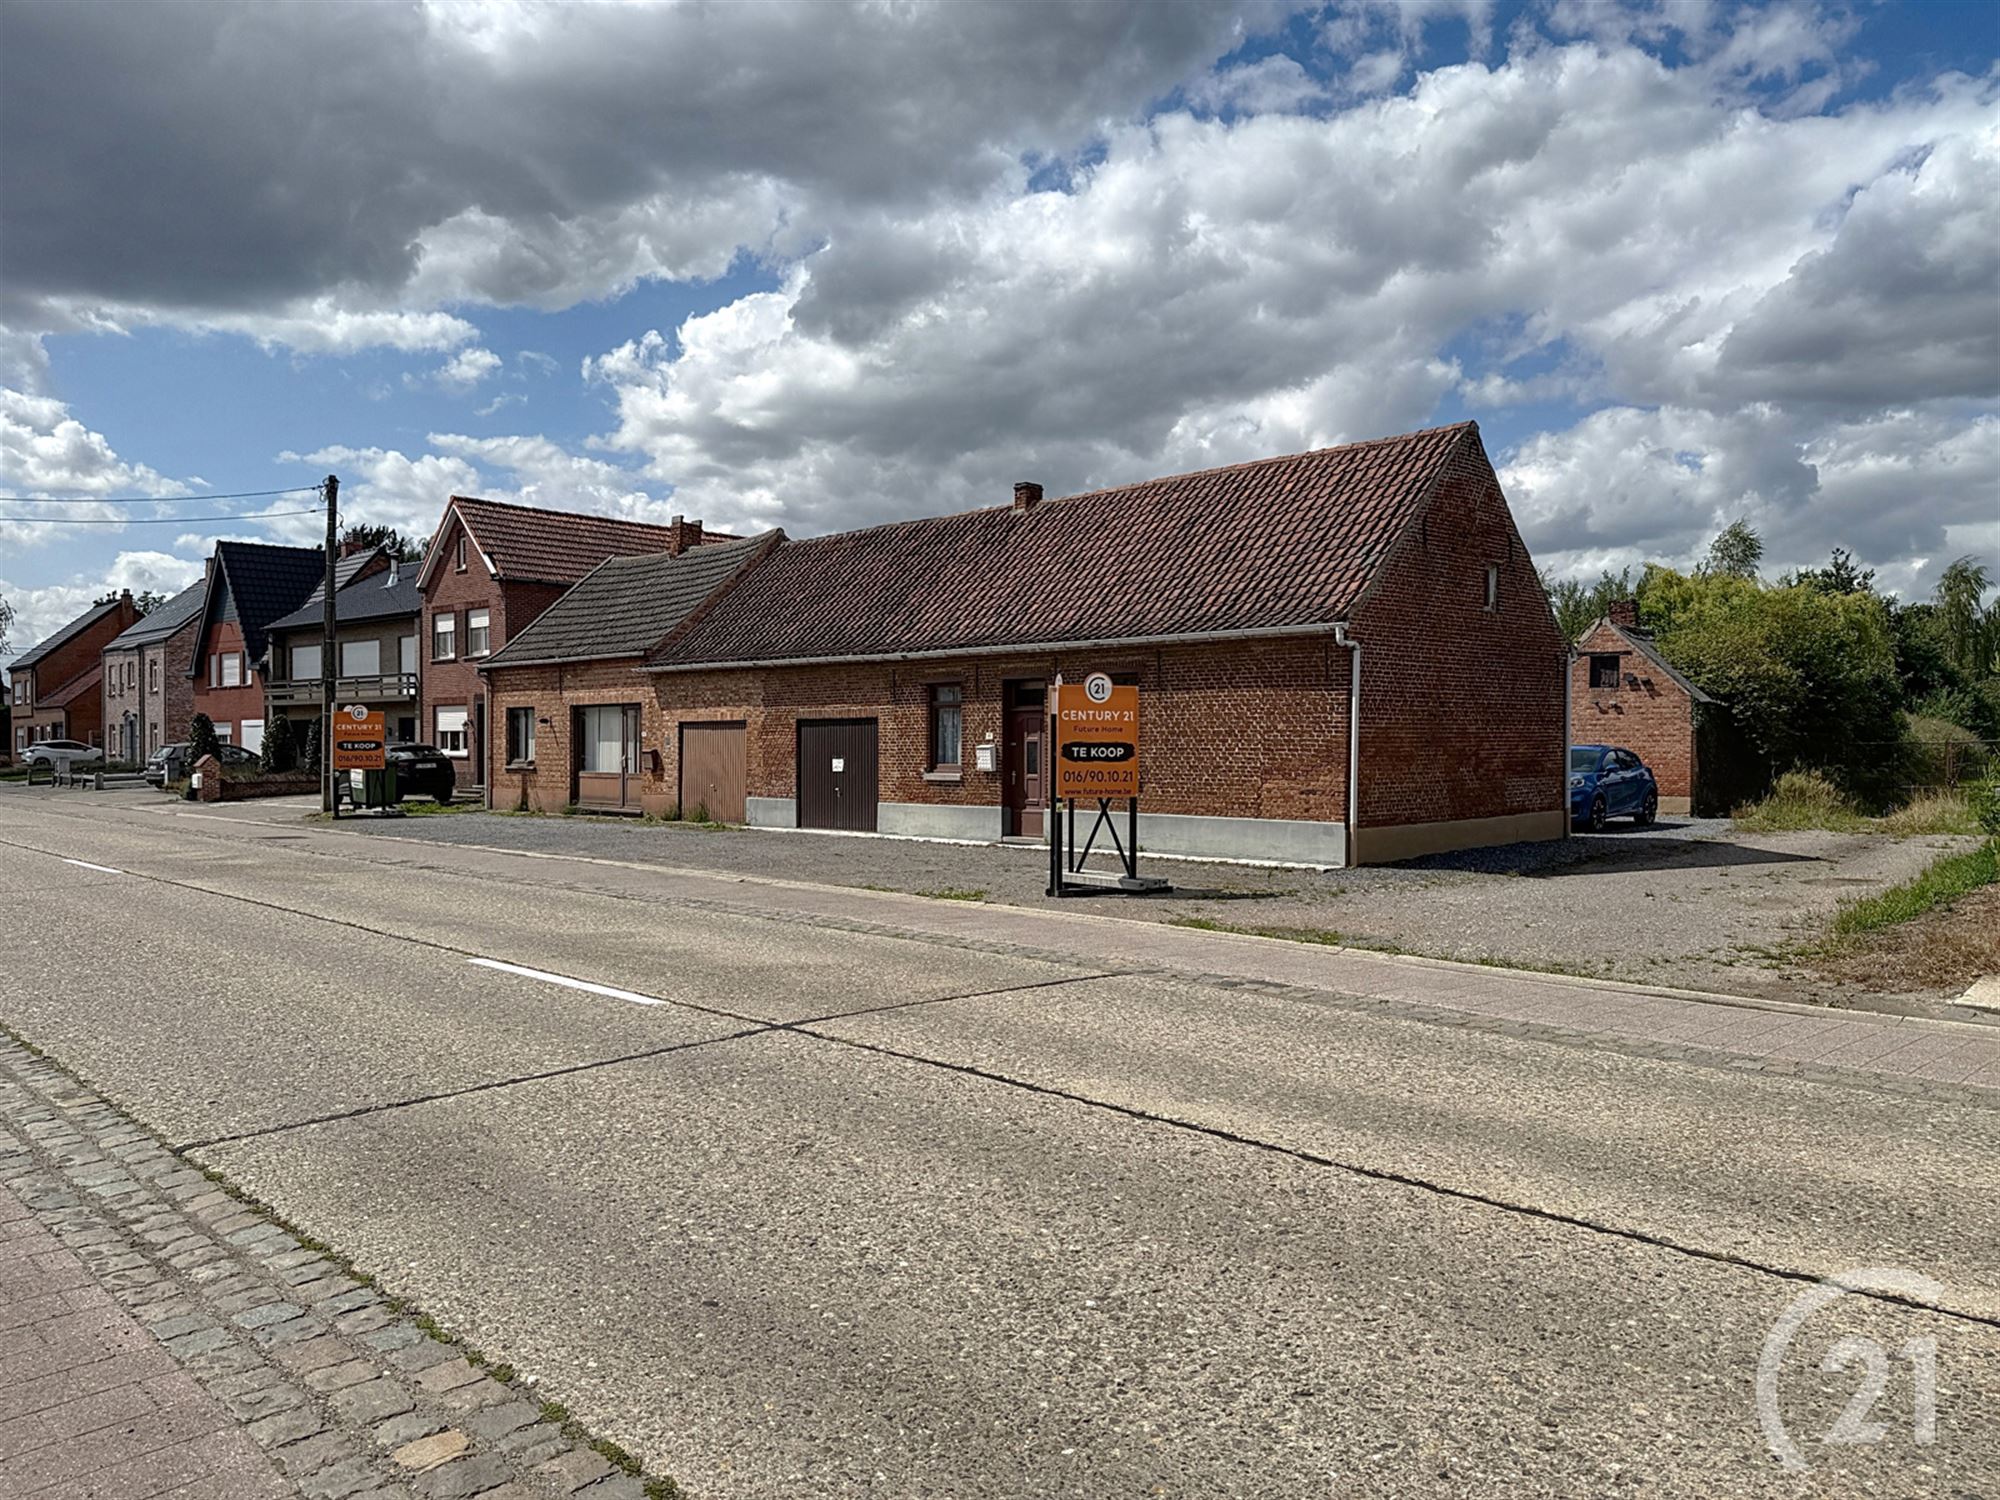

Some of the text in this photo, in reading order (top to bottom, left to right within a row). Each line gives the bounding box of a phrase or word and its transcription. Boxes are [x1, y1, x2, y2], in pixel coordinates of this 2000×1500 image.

[1061, 710, 1134, 722] CENTURY 21
[1073, 725, 1123, 733] Future Home
[1071, 747, 1125, 758] TE KOOP
[1063, 770, 1134, 783] 016/90.10.21
